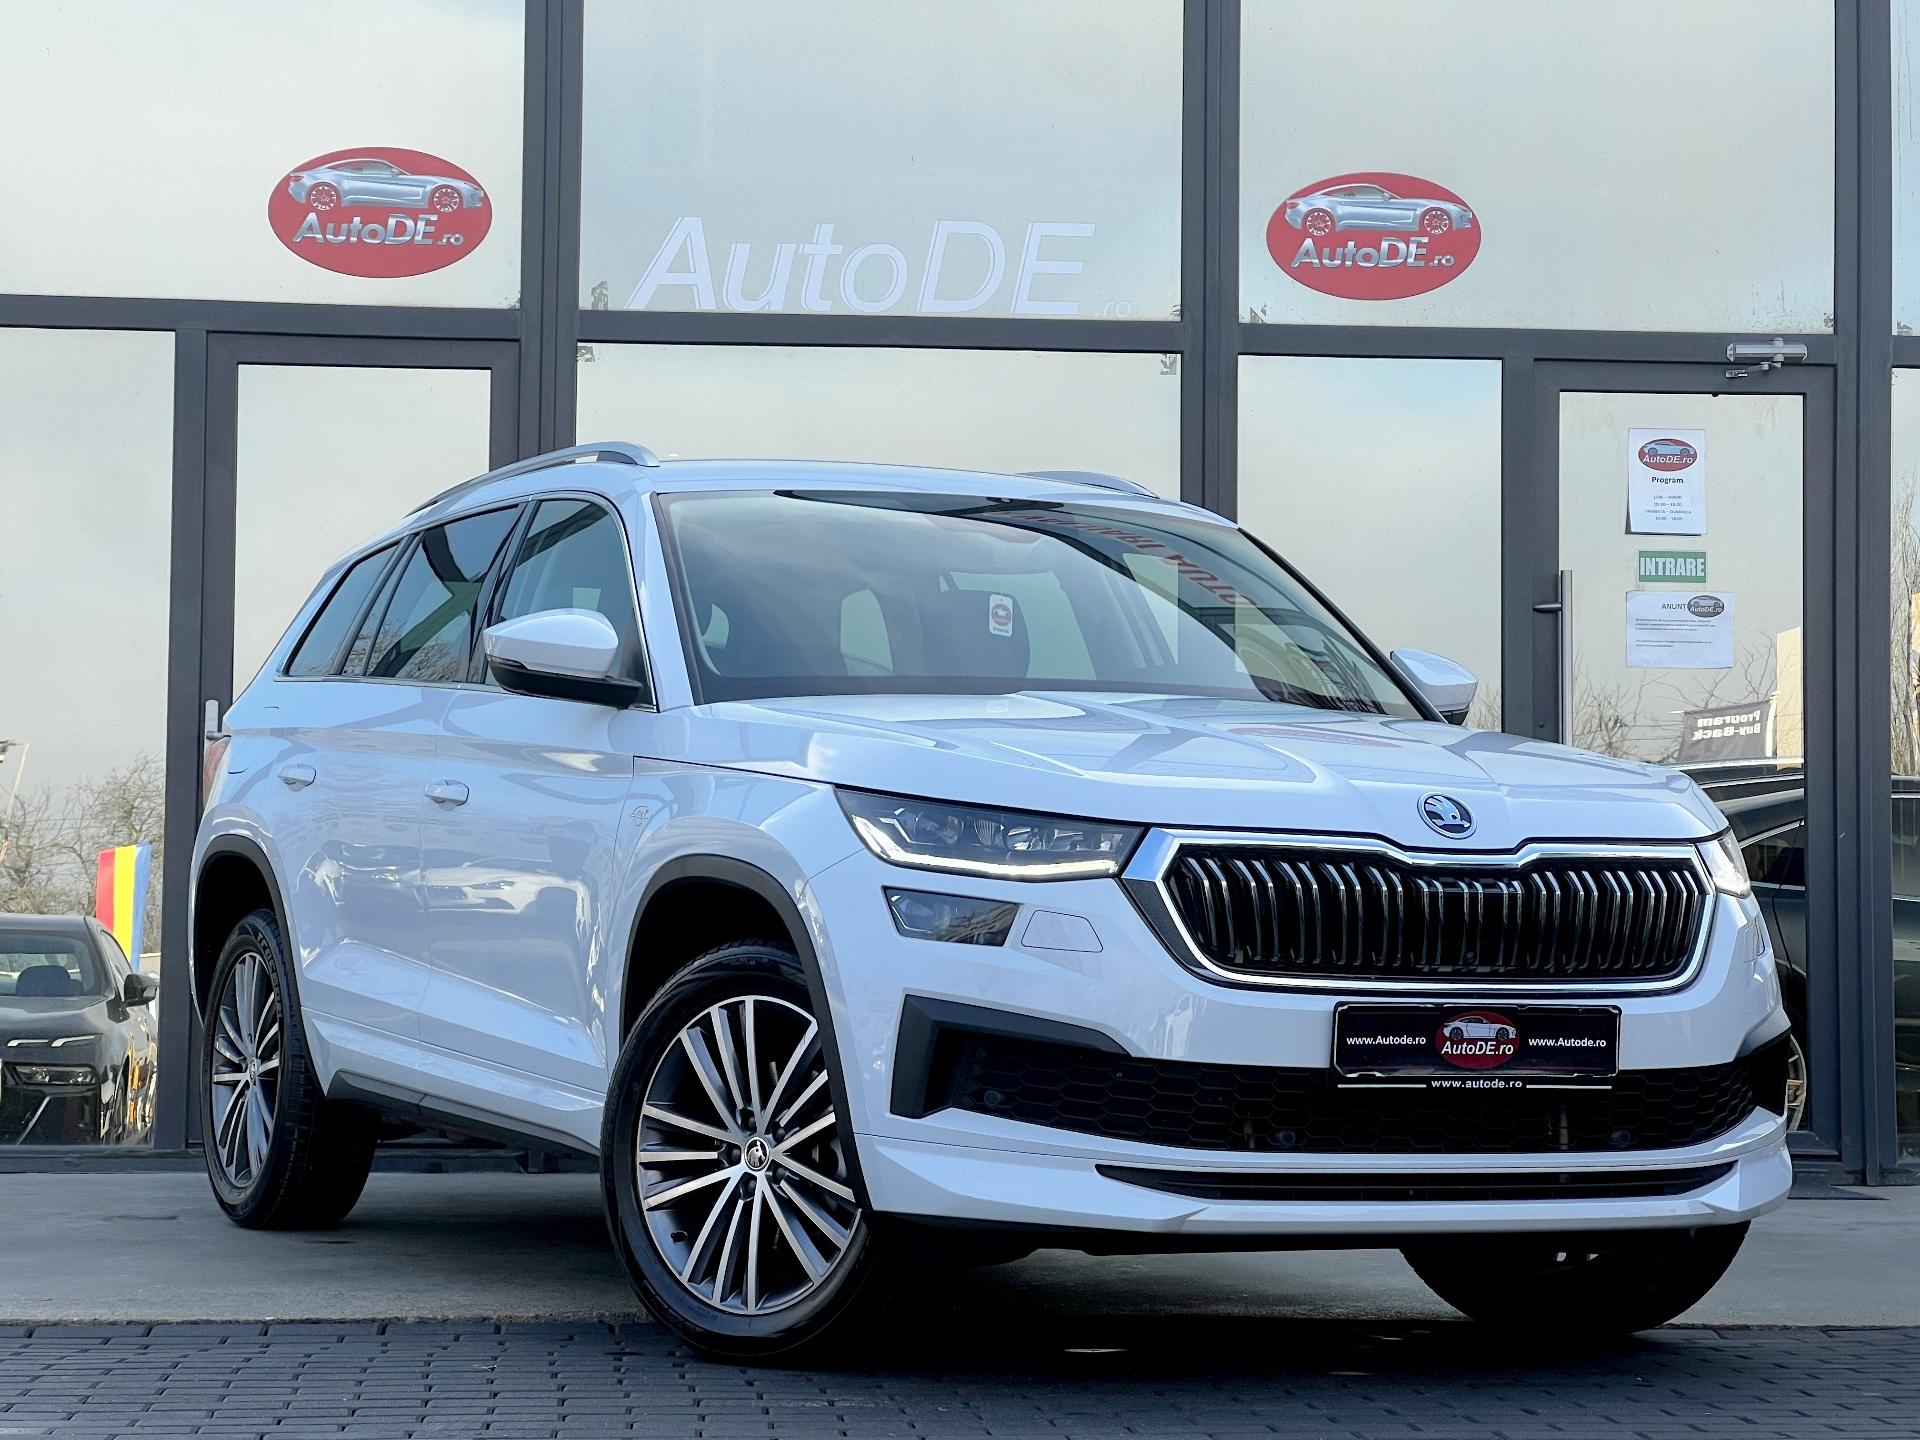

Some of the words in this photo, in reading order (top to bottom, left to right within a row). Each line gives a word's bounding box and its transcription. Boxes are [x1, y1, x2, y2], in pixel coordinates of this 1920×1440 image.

[1642, 454, 1694, 464] AutoDE.ro
[1651, 476, 1684, 485] Program
[1639, 557, 1705, 577] INTRARE
[1346, 1034, 1427, 1046] www.Autode.ro
[1528, 1036, 1607, 1048] www.Autode.ro
[1441, 1041, 1514, 1056] AutoDE.ro
[1431, 1078, 1523, 1089] www.autode.ro
